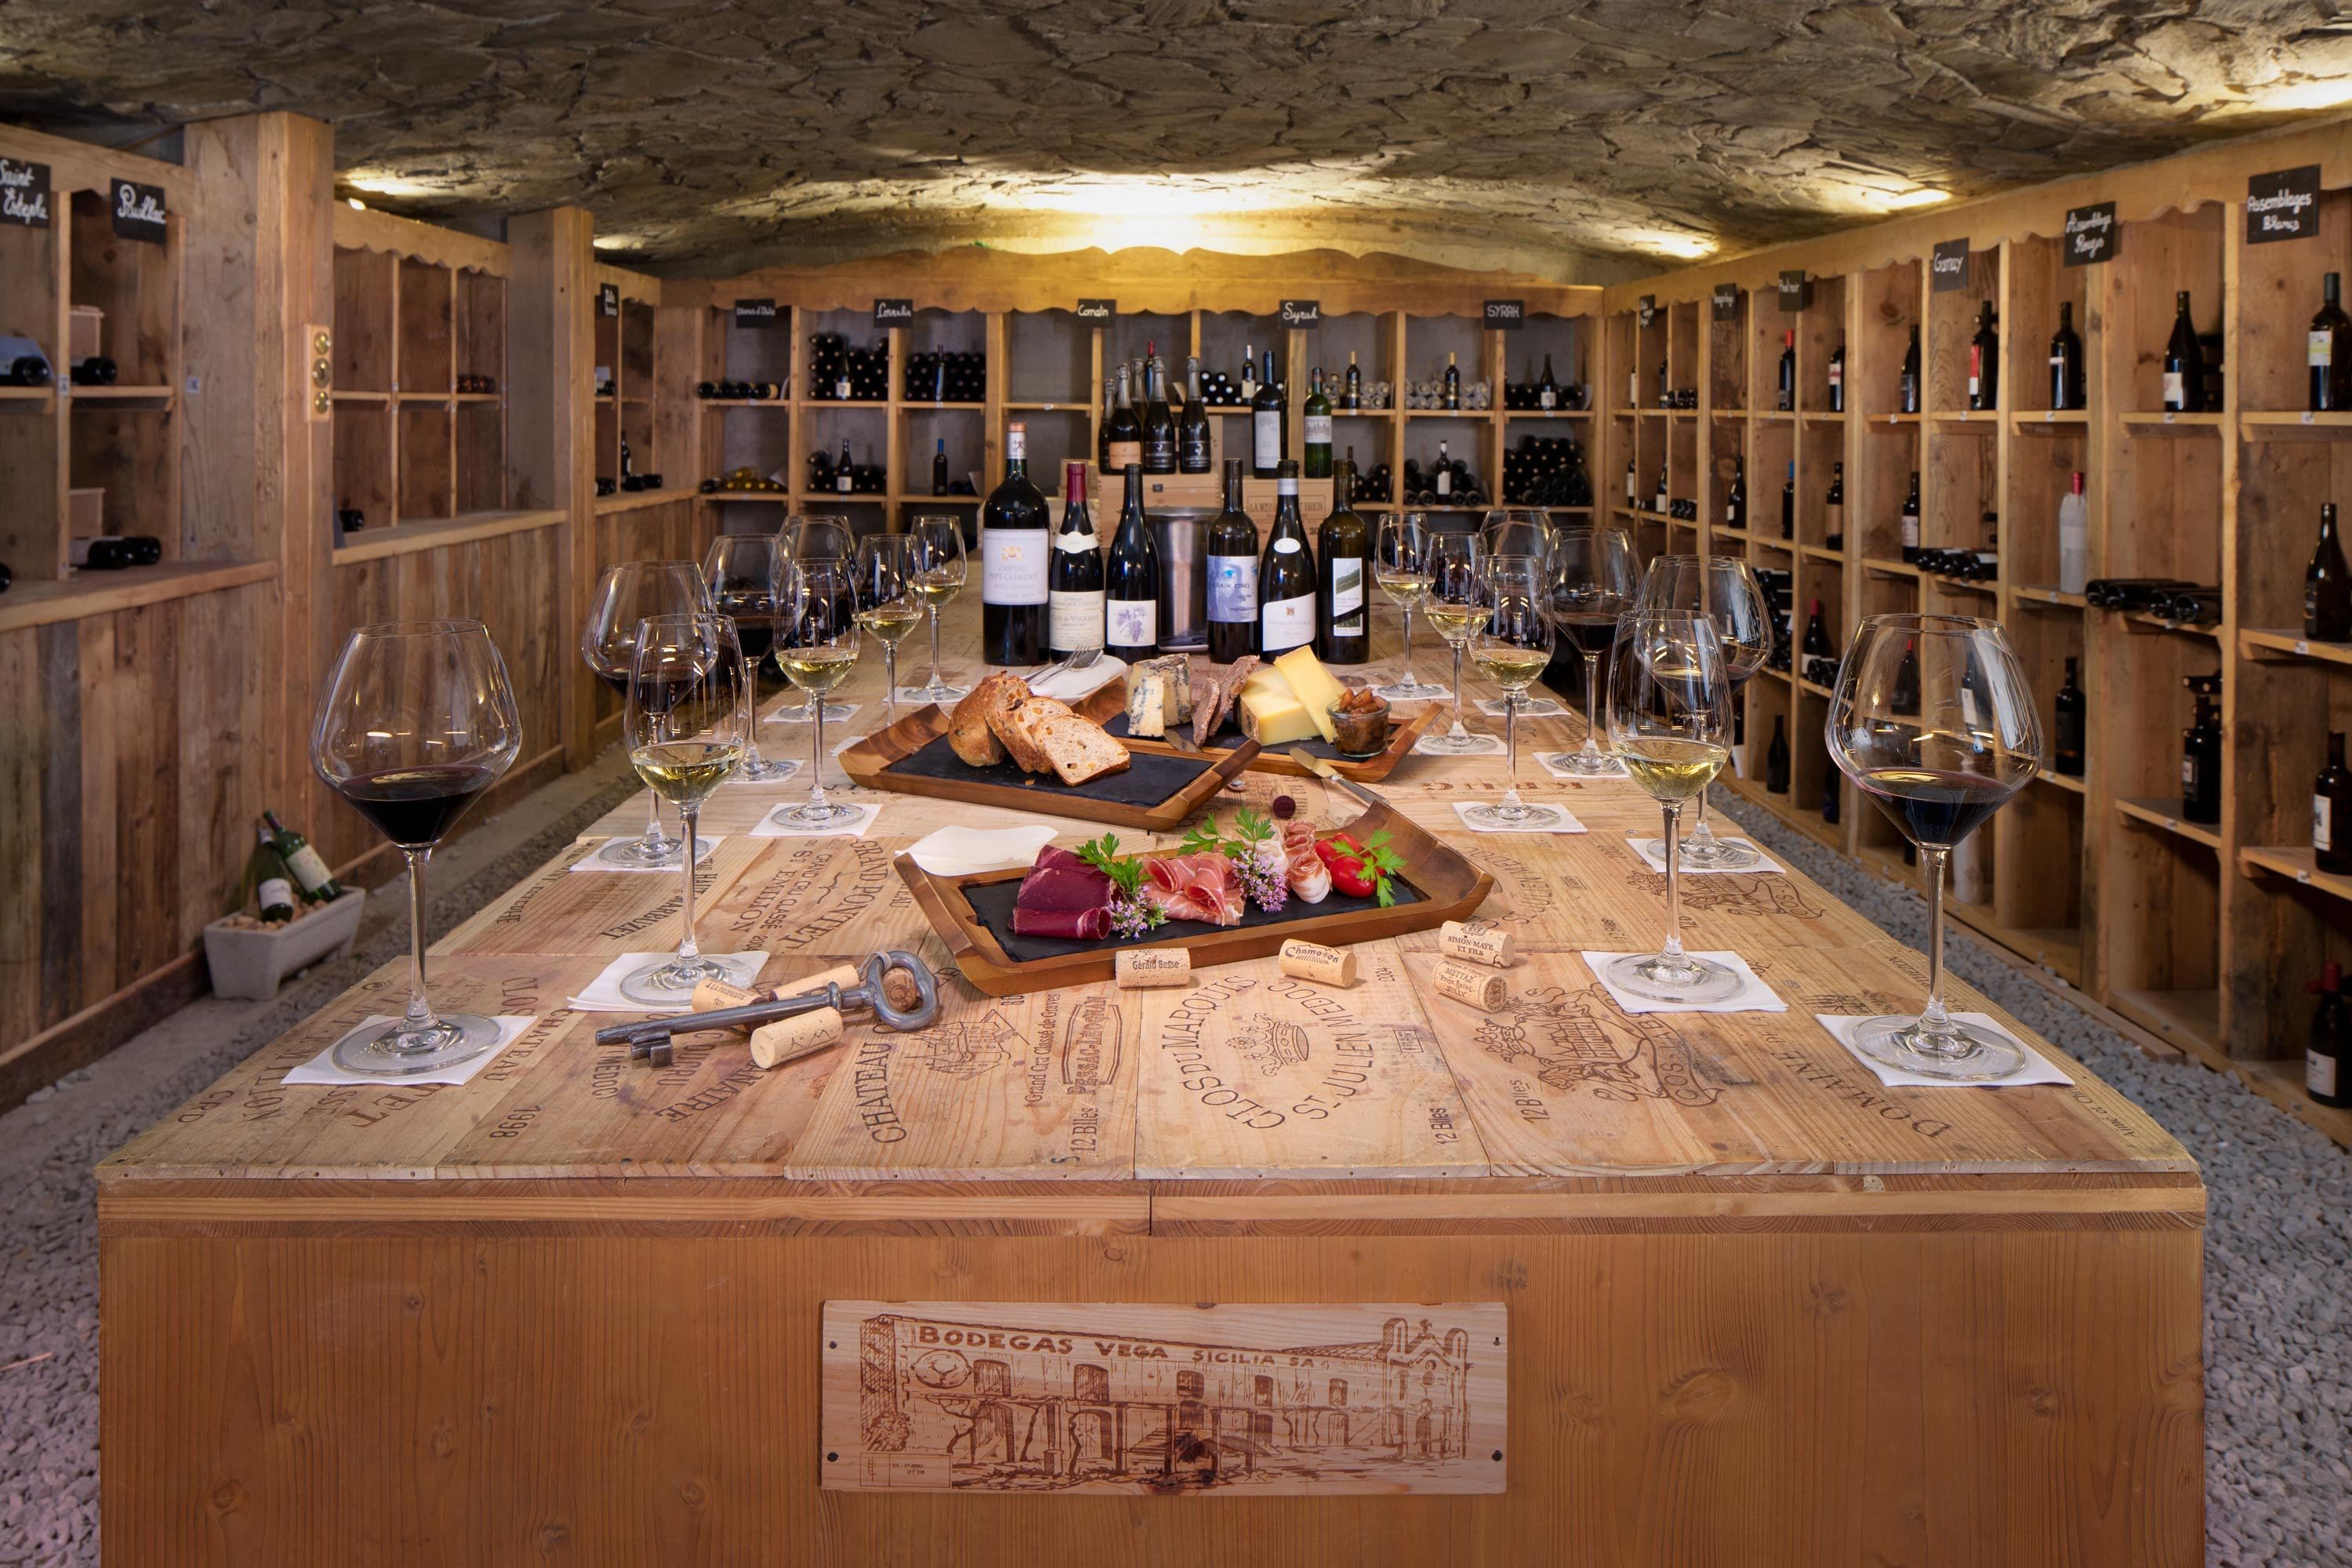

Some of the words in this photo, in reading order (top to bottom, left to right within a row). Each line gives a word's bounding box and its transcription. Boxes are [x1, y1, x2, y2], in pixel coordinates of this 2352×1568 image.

[2247, 188, 2312, 215] Assemblages
[1283, 302, 1319, 325] Syrah
[1487, 304, 1519, 318] SYRAH
[1285, 946, 1340, 964] Chamoson
[1457, 945, 1466, 953] ET
[1468, 948, 1484, 956] FILS
[1473, 941, 1494, 951] MAYE
[1132, 960, 1157, 971] Gérald
[1158, 960, 1180, 970] Besse
[1444, 967, 1474, 983] METTAZ
[1041, 993, 1061, 1018] Graves
[1161, 975, 1258, 1051] MARQUIS
[1043, 1018, 1056, 1030] de
[855, 1042, 908, 1143] CHATEAU
[1770, 1050, 1952, 1139] DOMAINE
[177, 1090, 235, 1123] CRD
[488, 1105, 543, 1138] 1998
[1522, 1108, 1551, 1124] 12
[1069, 1138, 1098, 1152] 12
[1435, 1132, 1460, 1145] 12
[918, 1326, 1073, 1356] BODEGAS
[1094, 1341, 1169, 1359] VEGA
[1191, 1349, 1276, 1365] SICILIA
[1288, 1356, 1315, 1367] SA
